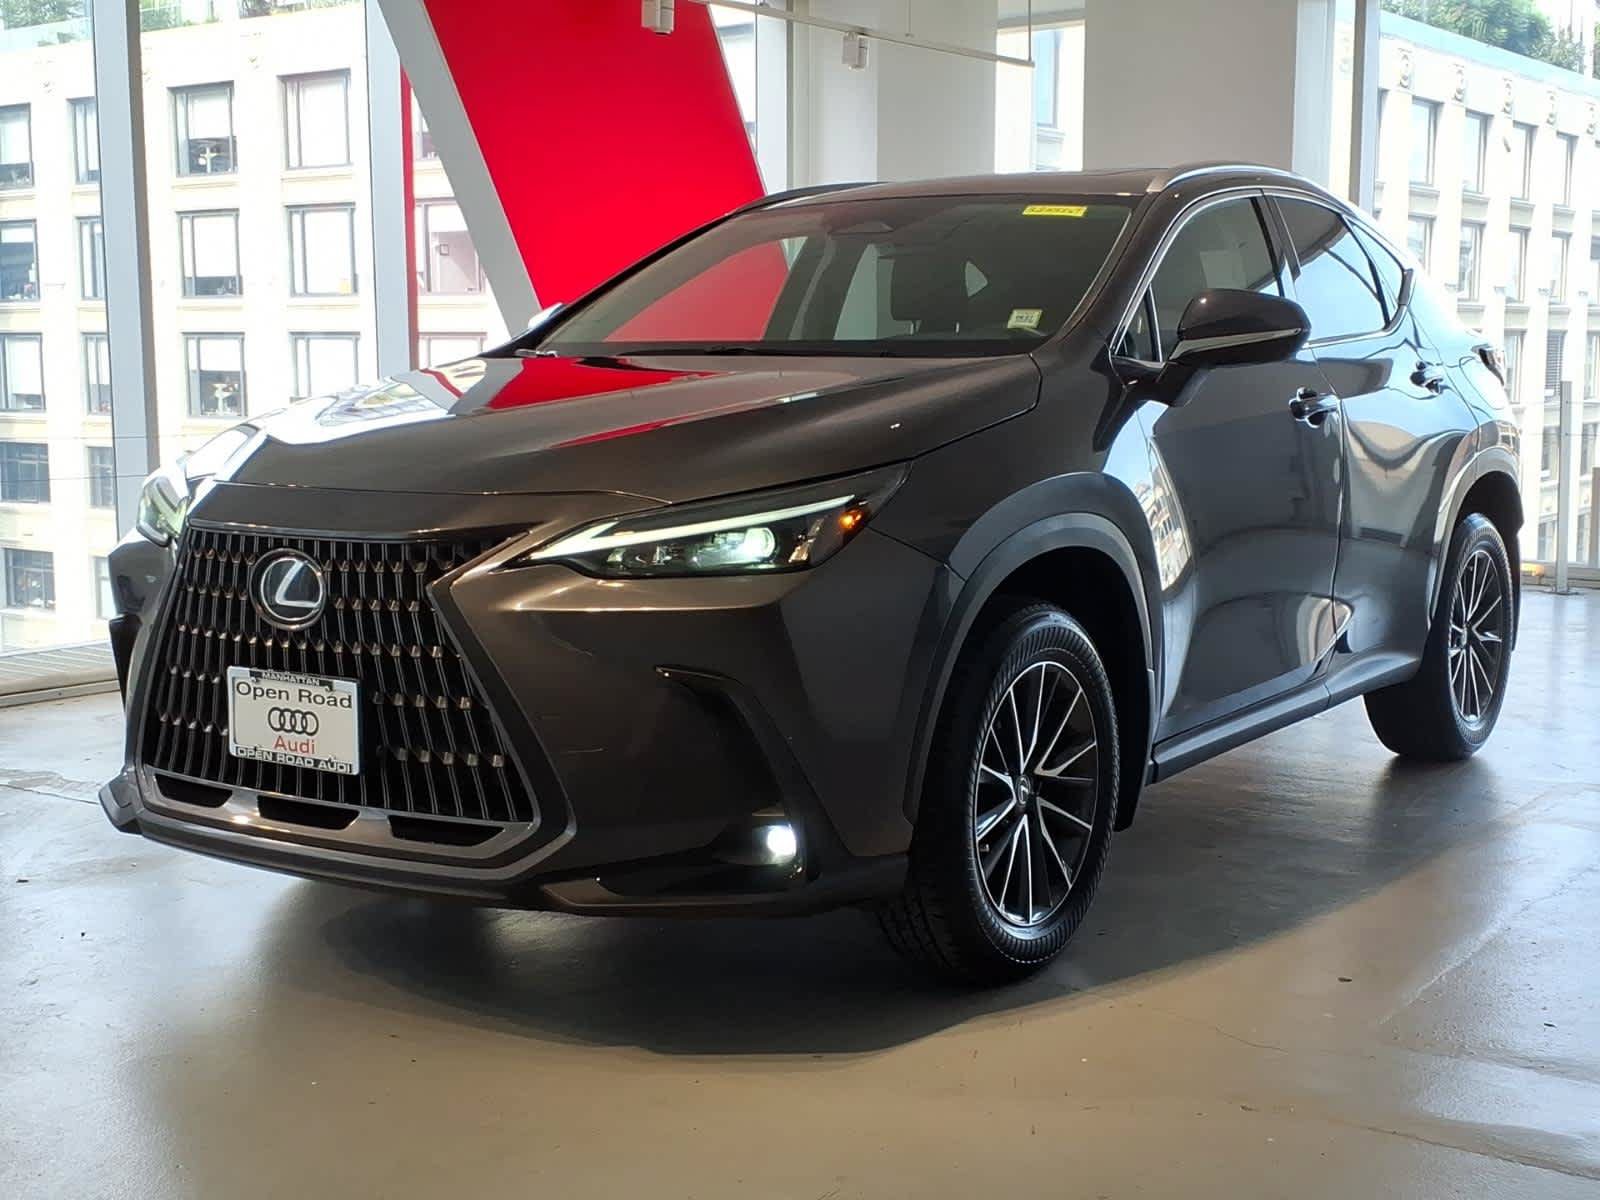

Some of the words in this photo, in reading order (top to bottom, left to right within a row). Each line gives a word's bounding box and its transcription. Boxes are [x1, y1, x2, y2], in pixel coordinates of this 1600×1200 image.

[262, 671, 320, 686] MANHATTAN
[236, 681, 290, 701] Open
[298, 688, 353, 709] Road
[274, 735, 315, 754] Audi
[237, 747, 273, 761] OPEN
[276, 753, 314, 767] ROAD
[318, 760, 353, 774] AUDI
